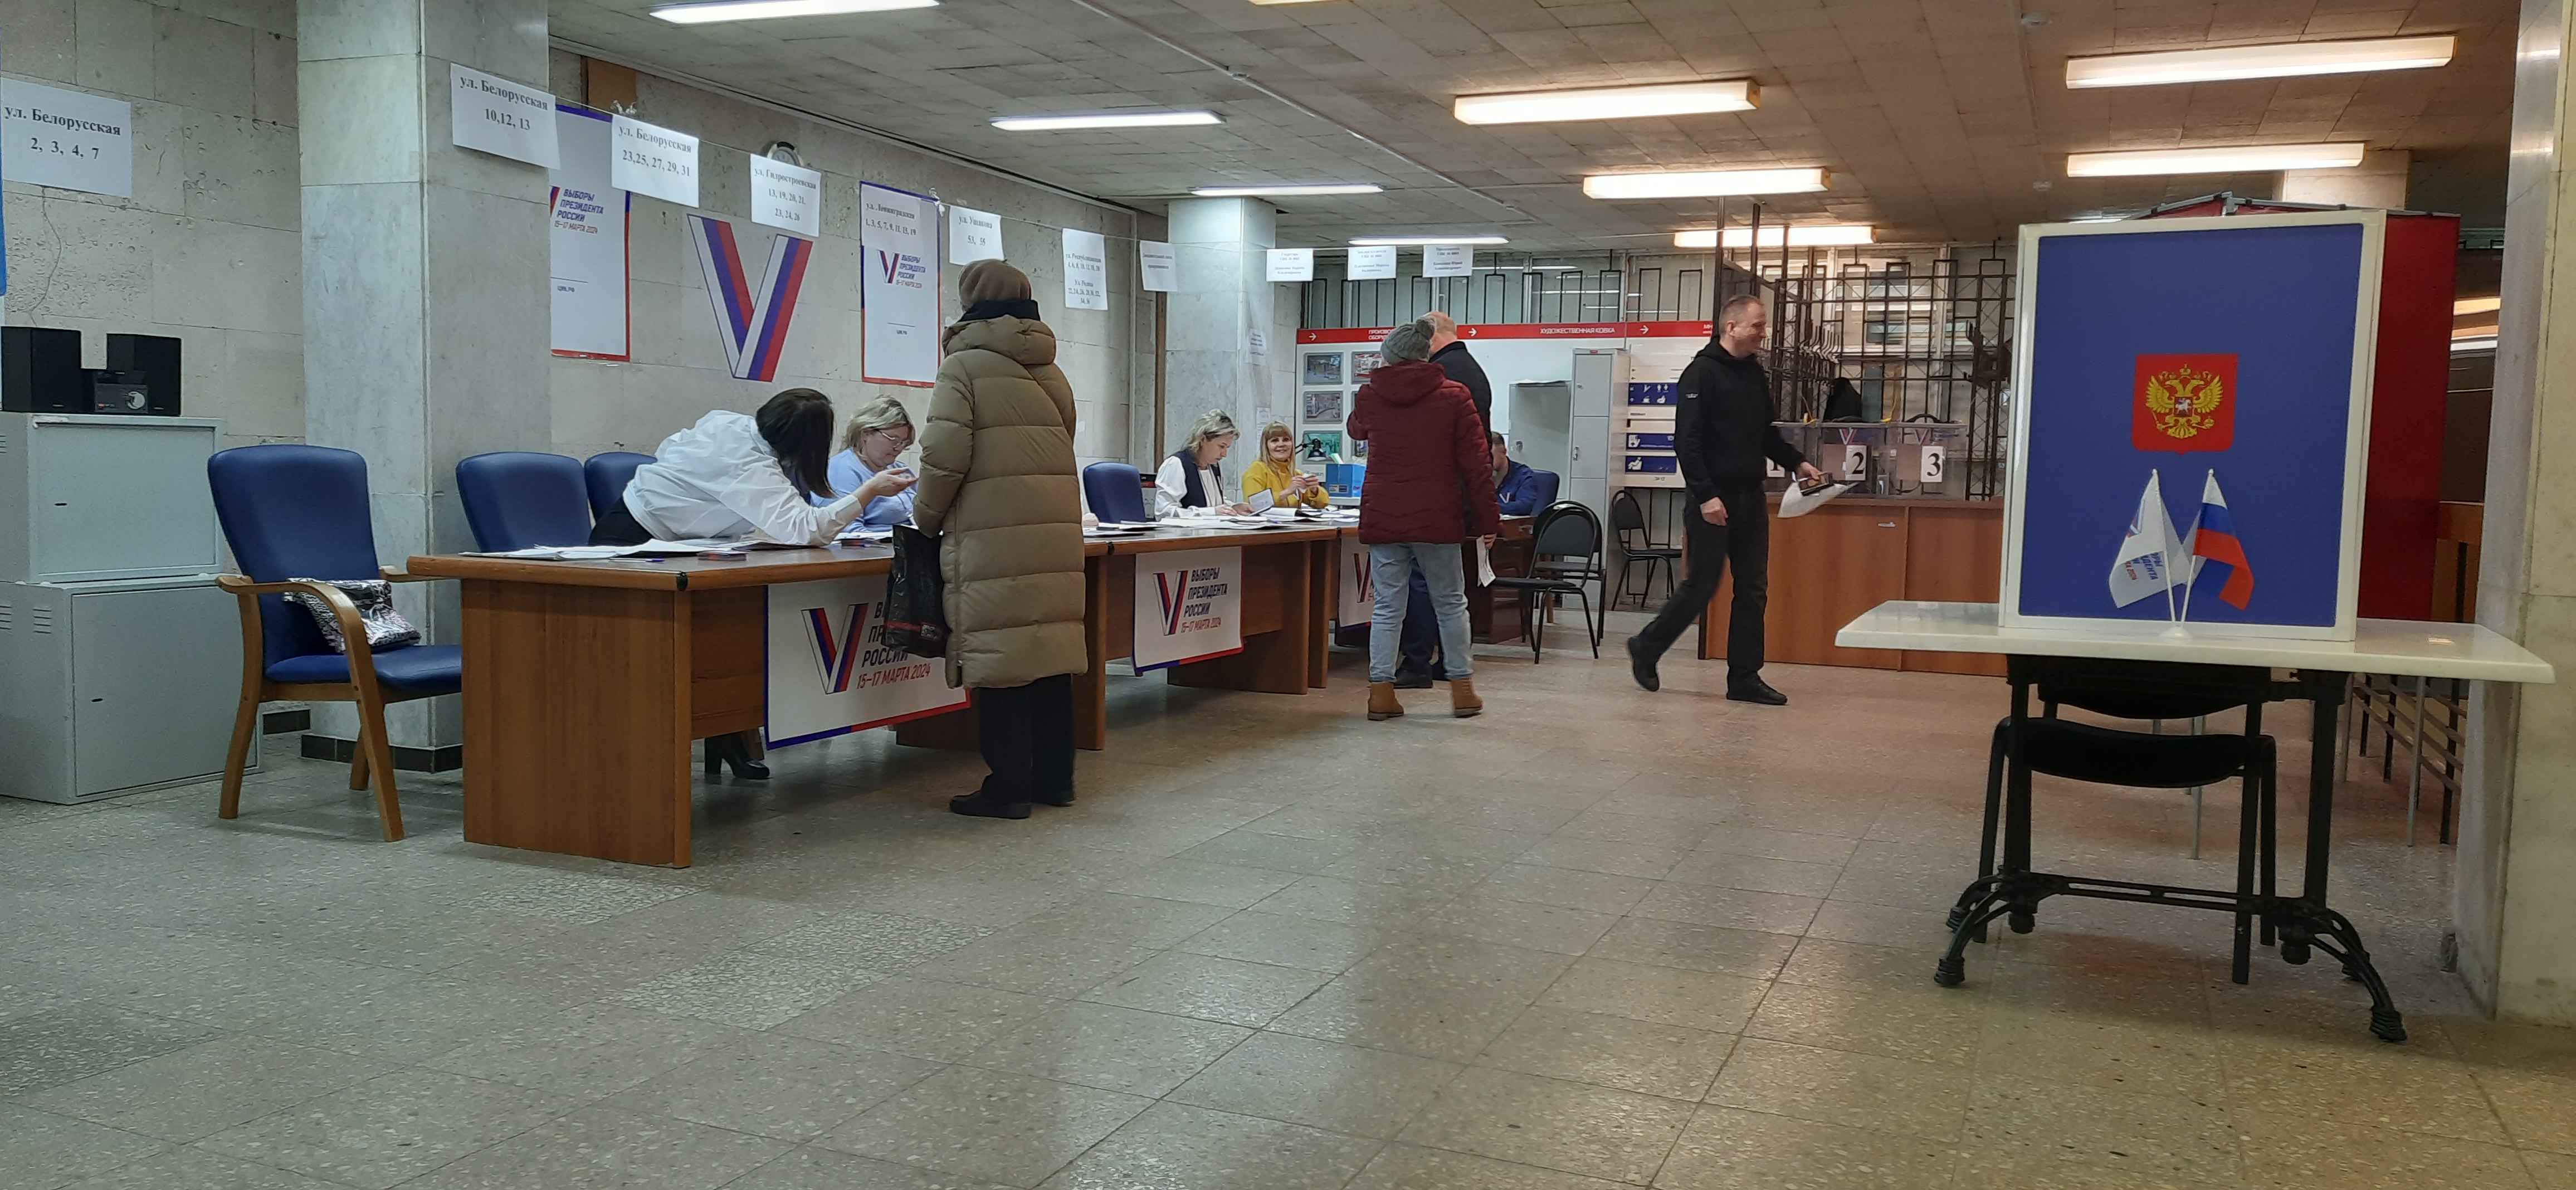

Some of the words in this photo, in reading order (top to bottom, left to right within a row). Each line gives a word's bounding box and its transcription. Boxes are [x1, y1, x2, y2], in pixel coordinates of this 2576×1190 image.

[460, 77, 477, 88] ул.
[481, 80, 548, 110] Белорусская
[4, 107, 27, 119] ул.
[31, 108, 121, 135] Белорусская
[520, 118, 530, 130] 13
[30, 138, 43, 153] 2,
[51, 141, 64, 155] 3,
[72, 144, 84, 159] 4,
[92, 148, 99, 159] 7
[618, 126, 633, 137] ул.
[636, 128, 691, 153] Белорусская
[652, 158, 665, 172] 27,
[682, 165, 690, 177] 31
[563, 189, 595, 201] ВЫБОРЫ
[557, 210, 585, 222] РОССИИ
[560, 199, 604, 214] ПРЕЗИДЕНТА
[1852, 452, 1865, 474] 2
[1926, 453, 1940, 476] 3
[1191, 567, 1220, 582] ВЫБОРЫ
[1188, 583, 1228, 600] ПРЕЗИДЕНТА
[1183, 602, 1211, 618] РОССИИ
[882, 666, 909, 685] МАРТА
[910, 662, 931, 679] 2024
